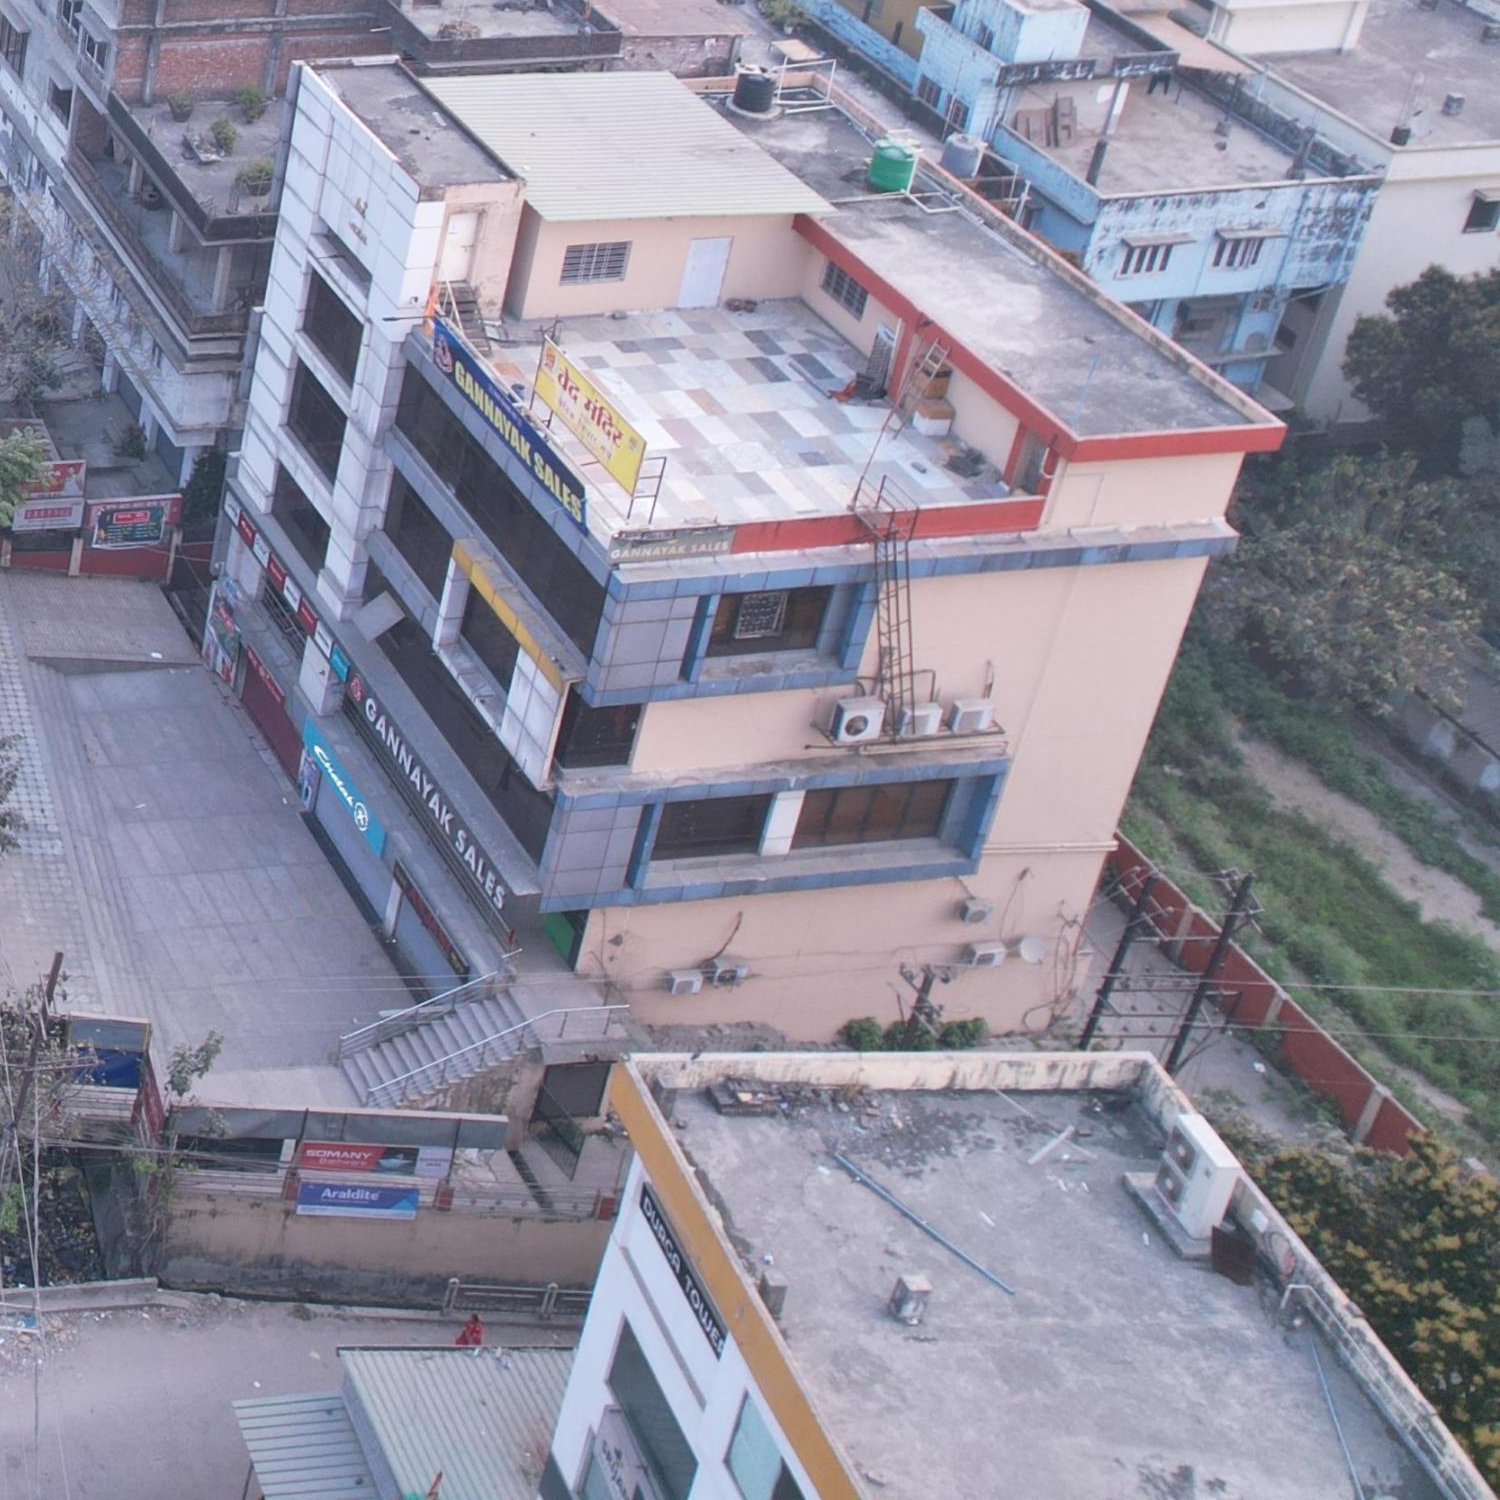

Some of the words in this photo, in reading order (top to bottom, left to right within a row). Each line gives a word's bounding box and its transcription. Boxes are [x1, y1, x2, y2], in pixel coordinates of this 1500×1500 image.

[455, 361, 532, 466] GANNAYAK
[533, 451, 583, 524] SALES
[610, 545, 685, 559] GANNAYAK
[690, 541, 729, 553] SALES
[365, 698, 455, 835] GANNAYAK
[455, 829, 506, 909] SALES
[305, 1149, 372, 1160] SOMANY
[320, 1187, 379, 1202] Araldite
[642, 1197, 682, 1275] DURGA
